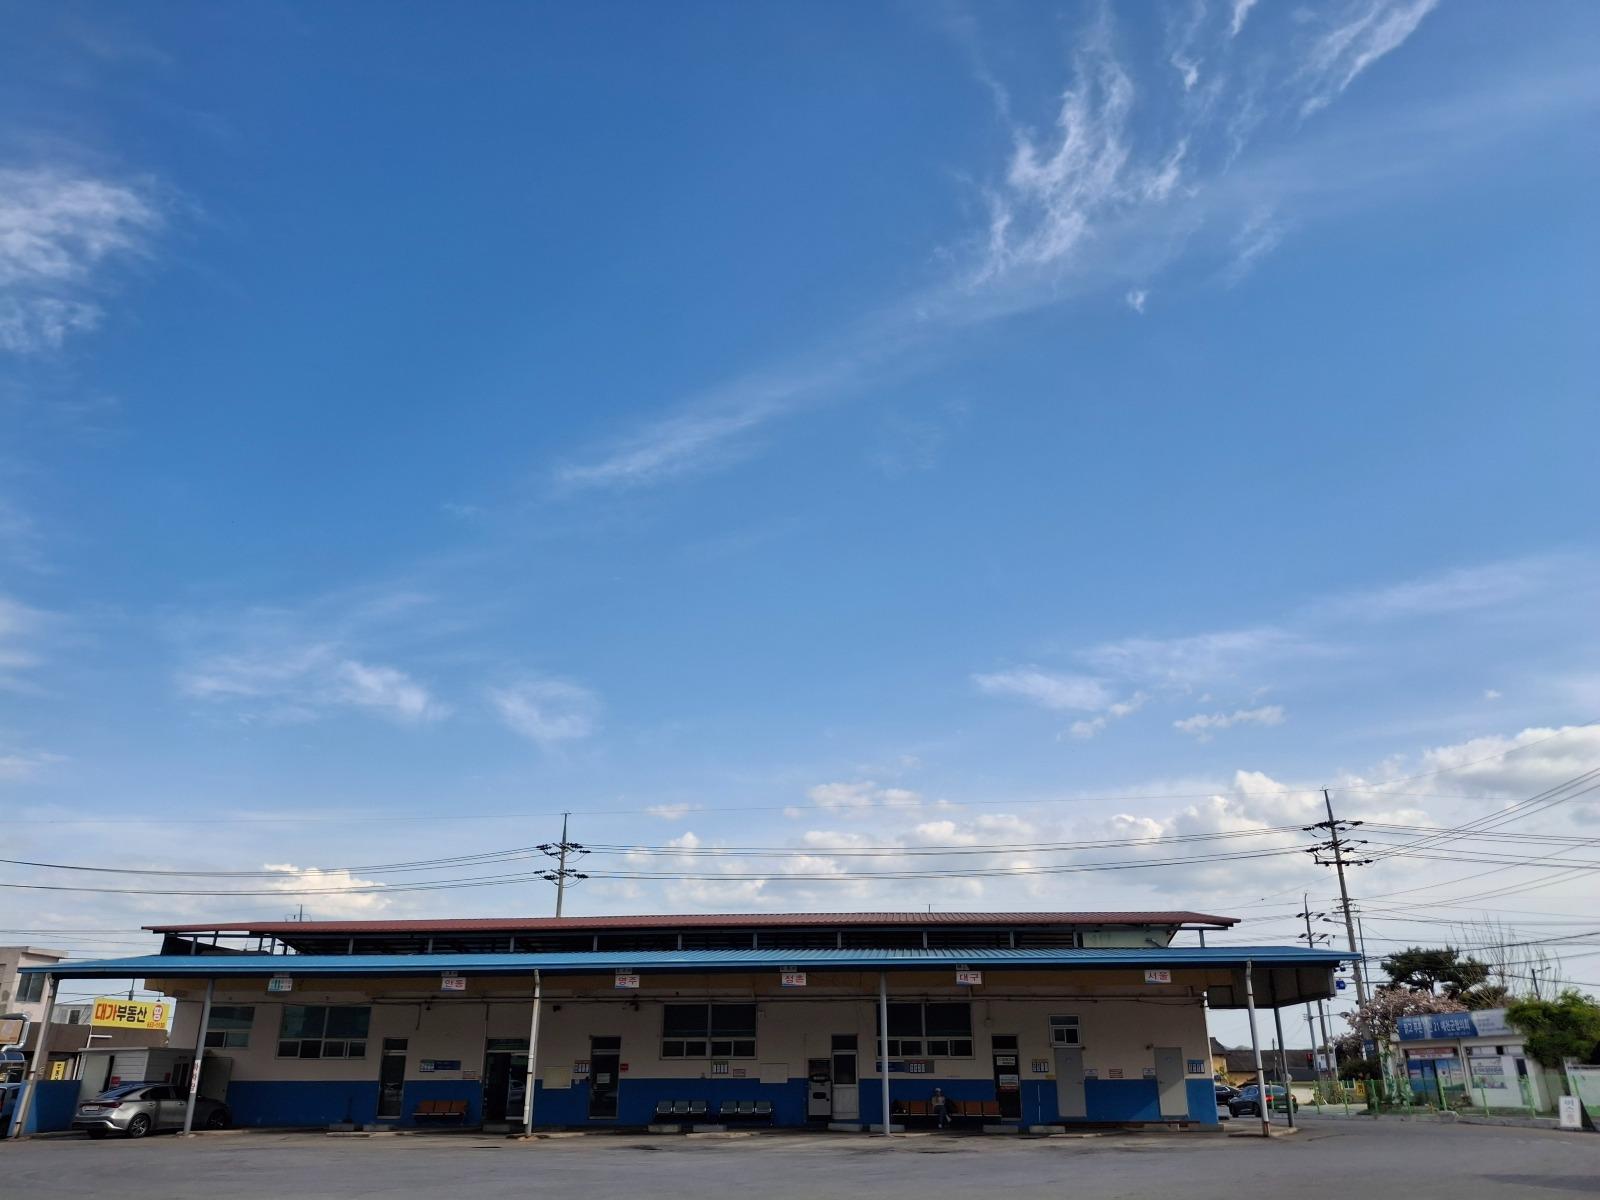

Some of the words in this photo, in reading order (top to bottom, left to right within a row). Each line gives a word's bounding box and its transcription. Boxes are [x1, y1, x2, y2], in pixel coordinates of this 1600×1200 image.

[959, 973, 979, 982] 대구
[1148, 971, 1168, 981] 서울
[444, 979, 464, 988] 안동
